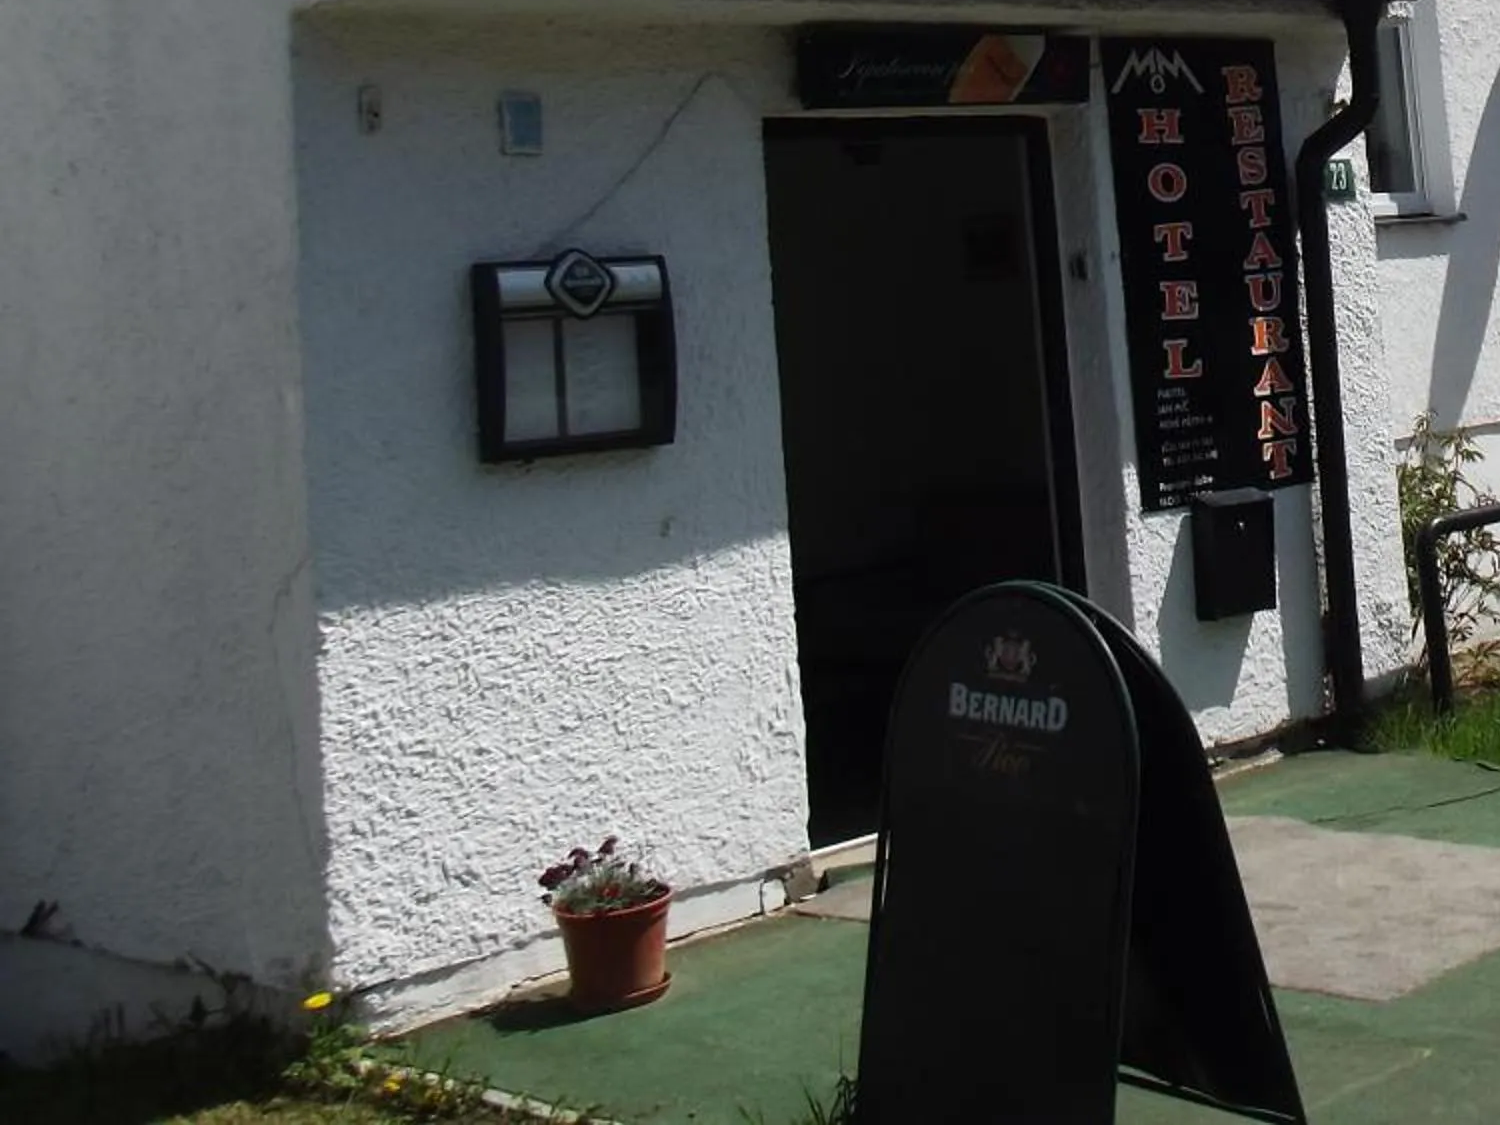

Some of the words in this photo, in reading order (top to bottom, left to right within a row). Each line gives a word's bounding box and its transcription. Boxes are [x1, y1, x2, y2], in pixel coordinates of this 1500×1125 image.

[1137, 108, 1202, 379] HOTEL
[1329, 162, 1347, 190] 73
[1222, 64, 1299, 480] RESTAURANT
[949, 682, 1068, 731] BERNARD
